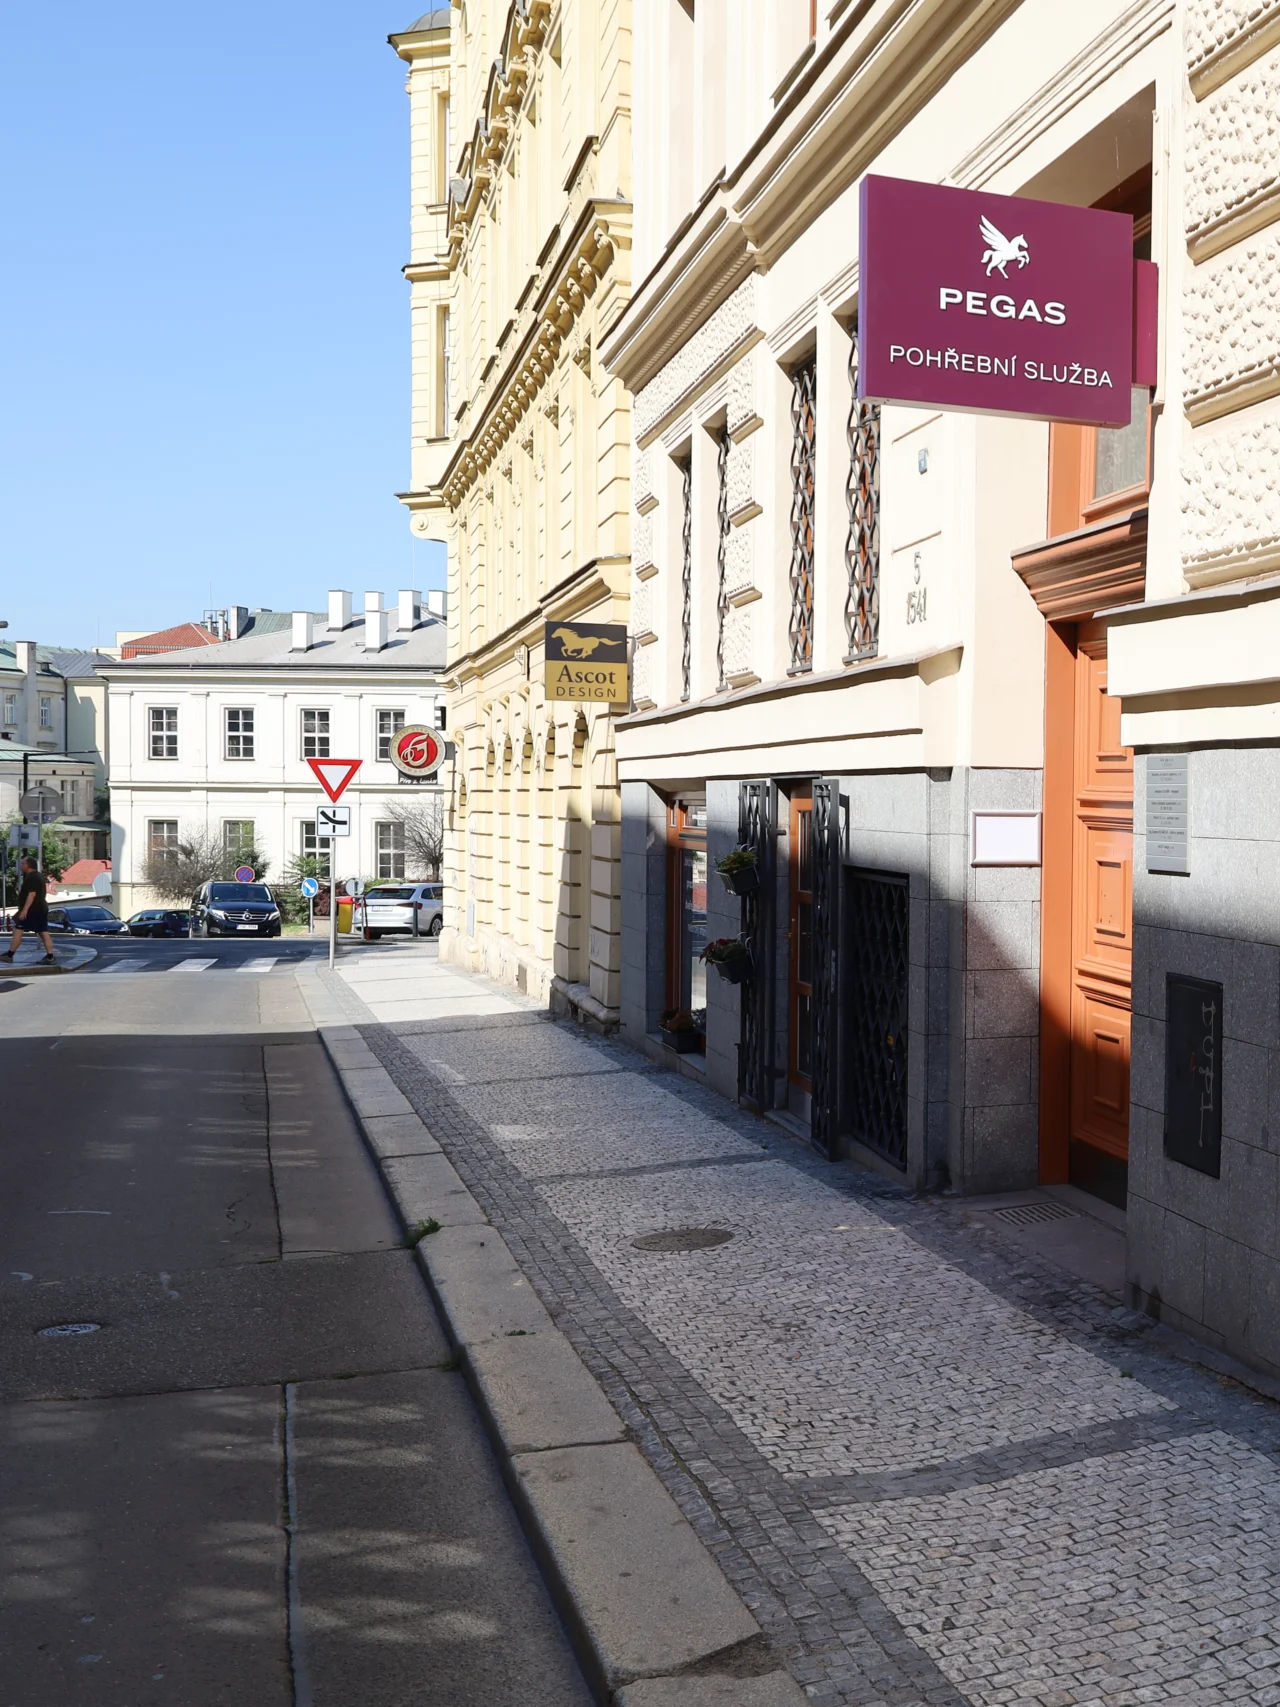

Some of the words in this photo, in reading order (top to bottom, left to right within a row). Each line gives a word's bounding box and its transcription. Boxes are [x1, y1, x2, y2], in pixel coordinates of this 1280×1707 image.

[939, 286, 1067, 326] PEGAS
[889, 344, 1018, 377] POHŘEBNÍ
[1023, 360, 1114, 389] SLUŽBA
[913, 551, 922, 585] 5
[906, 586, 928, 626] 1541
[556, 664, 616, 685] Ascot
[556, 686, 617, 698] DESIGN
